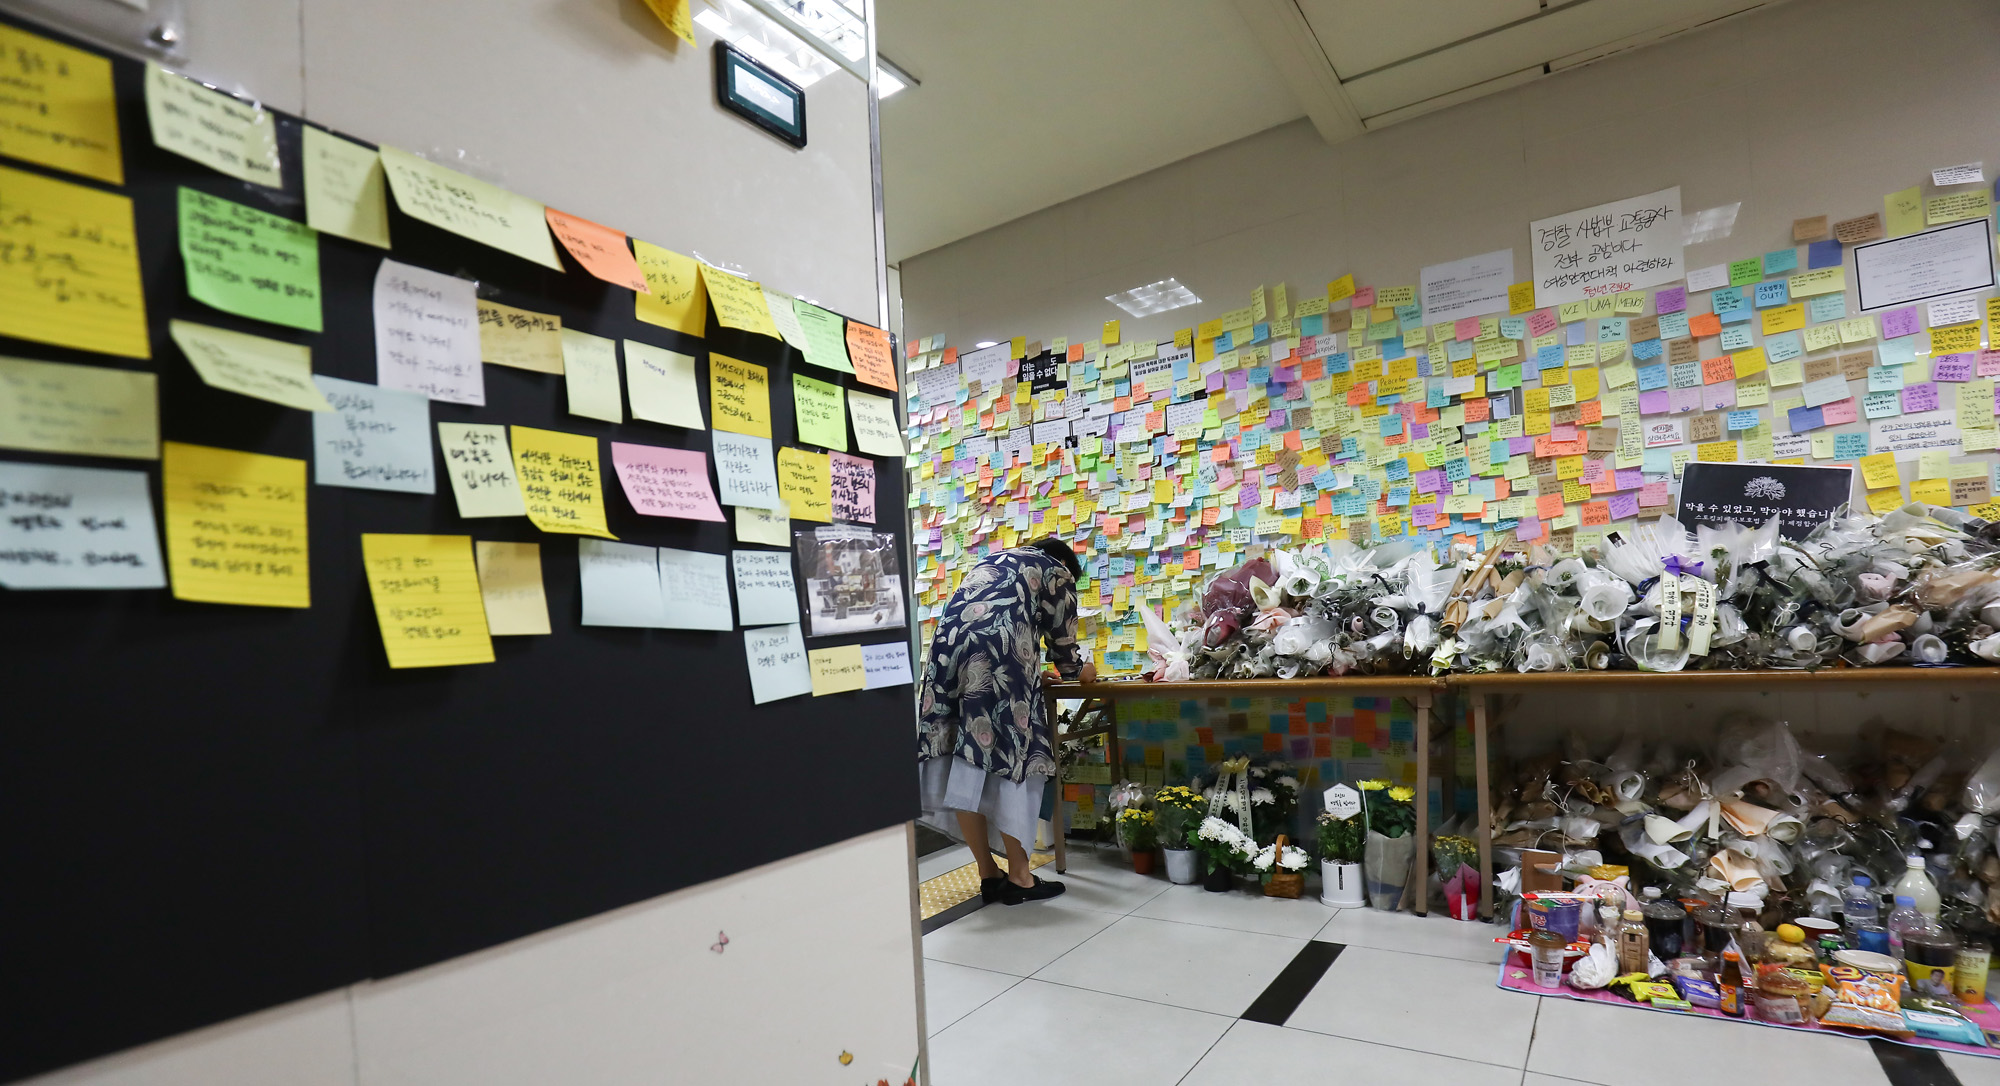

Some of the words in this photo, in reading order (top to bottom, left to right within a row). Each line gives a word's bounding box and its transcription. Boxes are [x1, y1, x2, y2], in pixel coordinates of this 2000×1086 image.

[1538, 224, 1572, 251] 경찰
[1554, 251, 1582, 269] 전부
[1588, 238, 1643, 262] 공범이다
[1624, 257, 1675, 273] 마련하라
[1562, 304, 1579, 316] NI
[1590, 298, 1611, 312] UNA
[1617, 297, 1645, 308] MENOS
[1022, 362, 1035, 372] 더는
[1036, 370, 1044, 379] 수
[1044, 366, 1057, 378] 없다
[1380, 377, 1398, 386] Peace
[717, 442, 760, 460] 여성가족부
[722, 460, 752, 474] 장관은
[729, 477, 773, 497] 사퇴하라
[1685, 502, 1706, 513] 막을
[1708, 503, 1719, 513] 수
[1722, 504, 1757, 516] 있었고,
